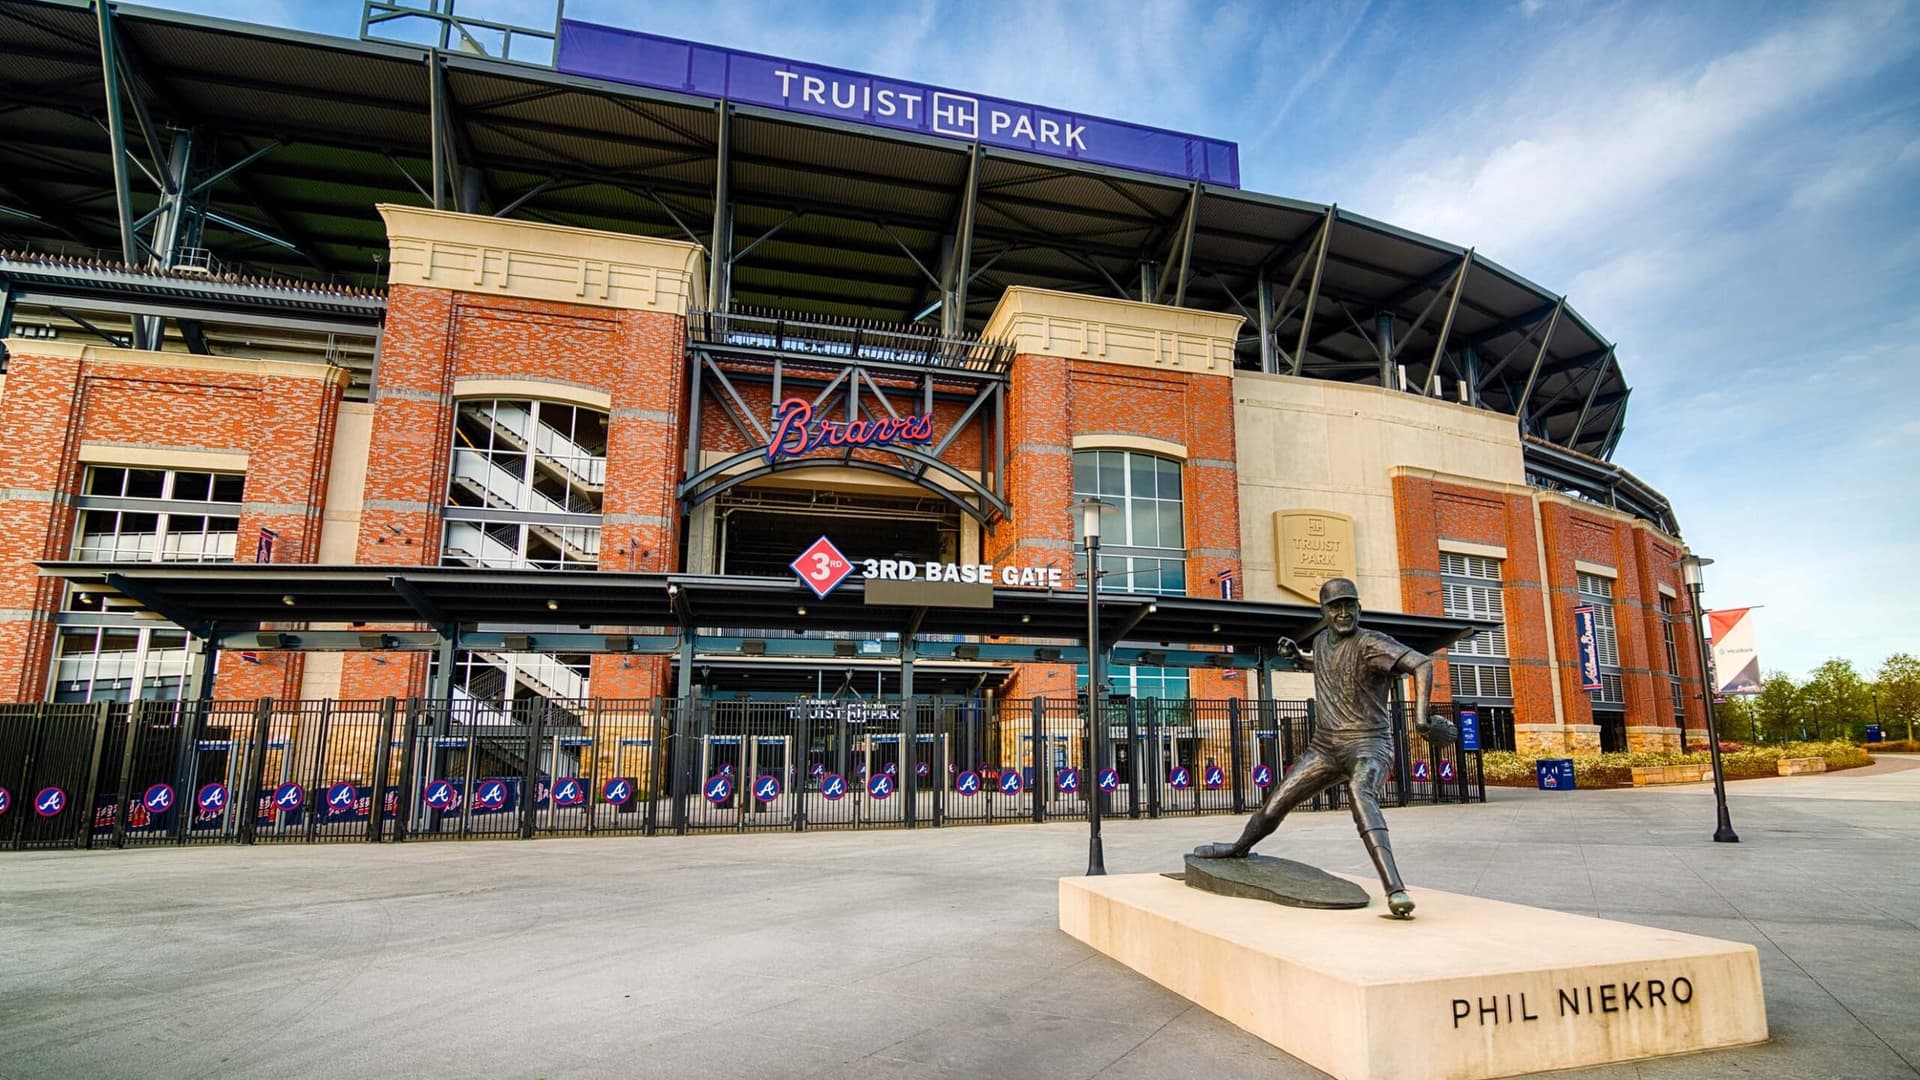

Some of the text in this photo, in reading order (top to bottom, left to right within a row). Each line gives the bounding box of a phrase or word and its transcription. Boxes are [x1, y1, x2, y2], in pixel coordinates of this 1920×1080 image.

[774, 70, 1088, 151] TRUIST PARK
[767, 398, 934, 461] Braves
[1292, 537, 1342, 553] TRUIST
[1300, 552, 1337, 566] PARK
[862, 558, 1062, 588] 3RD BASE GATE
[1451, 976, 1693, 1029] PHIL NIEKRO
